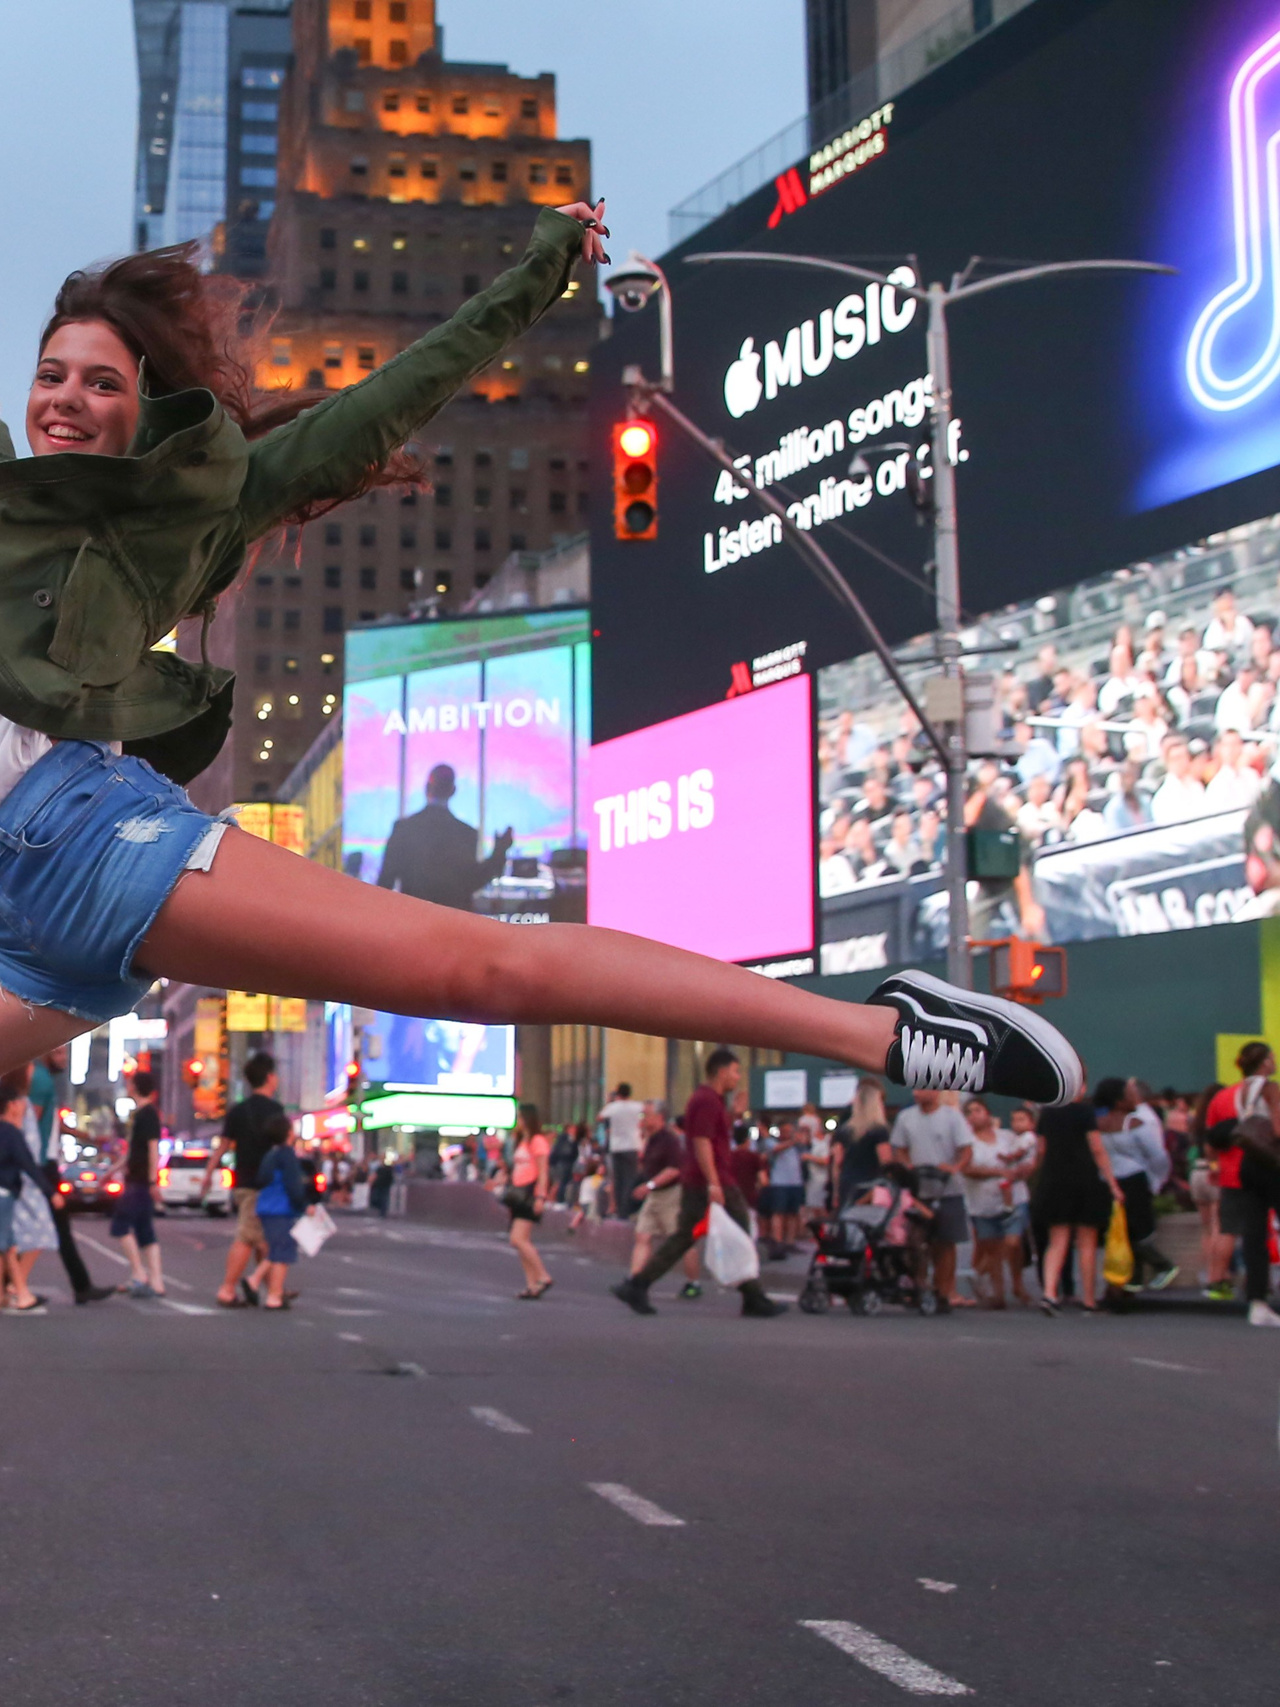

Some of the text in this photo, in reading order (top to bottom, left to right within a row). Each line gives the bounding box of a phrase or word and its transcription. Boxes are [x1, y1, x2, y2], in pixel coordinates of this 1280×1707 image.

[809, 102, 895, 173] MARRIOTT
[810, 132, 885, 195] MARQUIS
[764, 265, 916, 400] MUSIC
[754, 419, 845, 489] million
[704, 512, 782, 574] Listen
[876, 452, 909, 496] or
[383, 697, 561, 736] AMBITION
[593, 768, 715, 852] THIS IS
